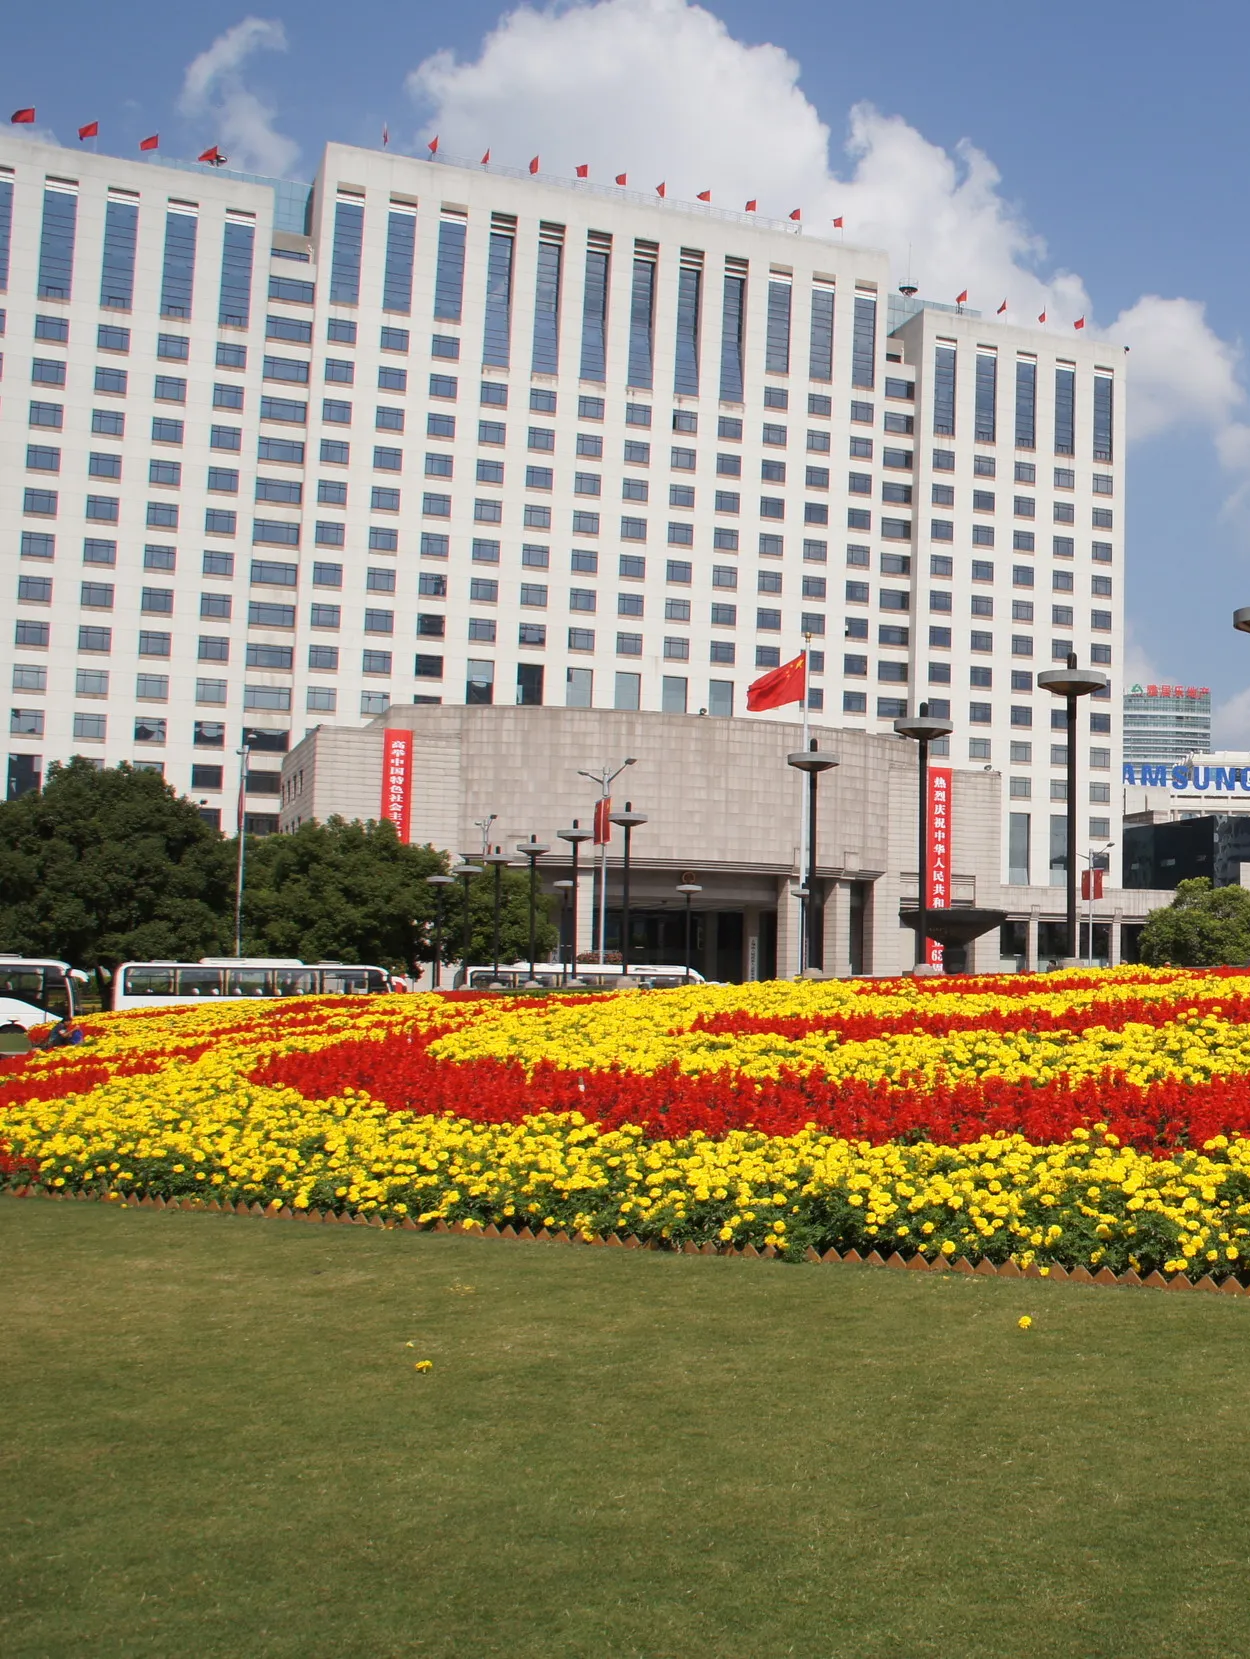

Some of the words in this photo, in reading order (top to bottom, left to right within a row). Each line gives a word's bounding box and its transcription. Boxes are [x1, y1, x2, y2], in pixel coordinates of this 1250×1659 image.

[389, 740, 406, 837] 高举中国特色社会主
